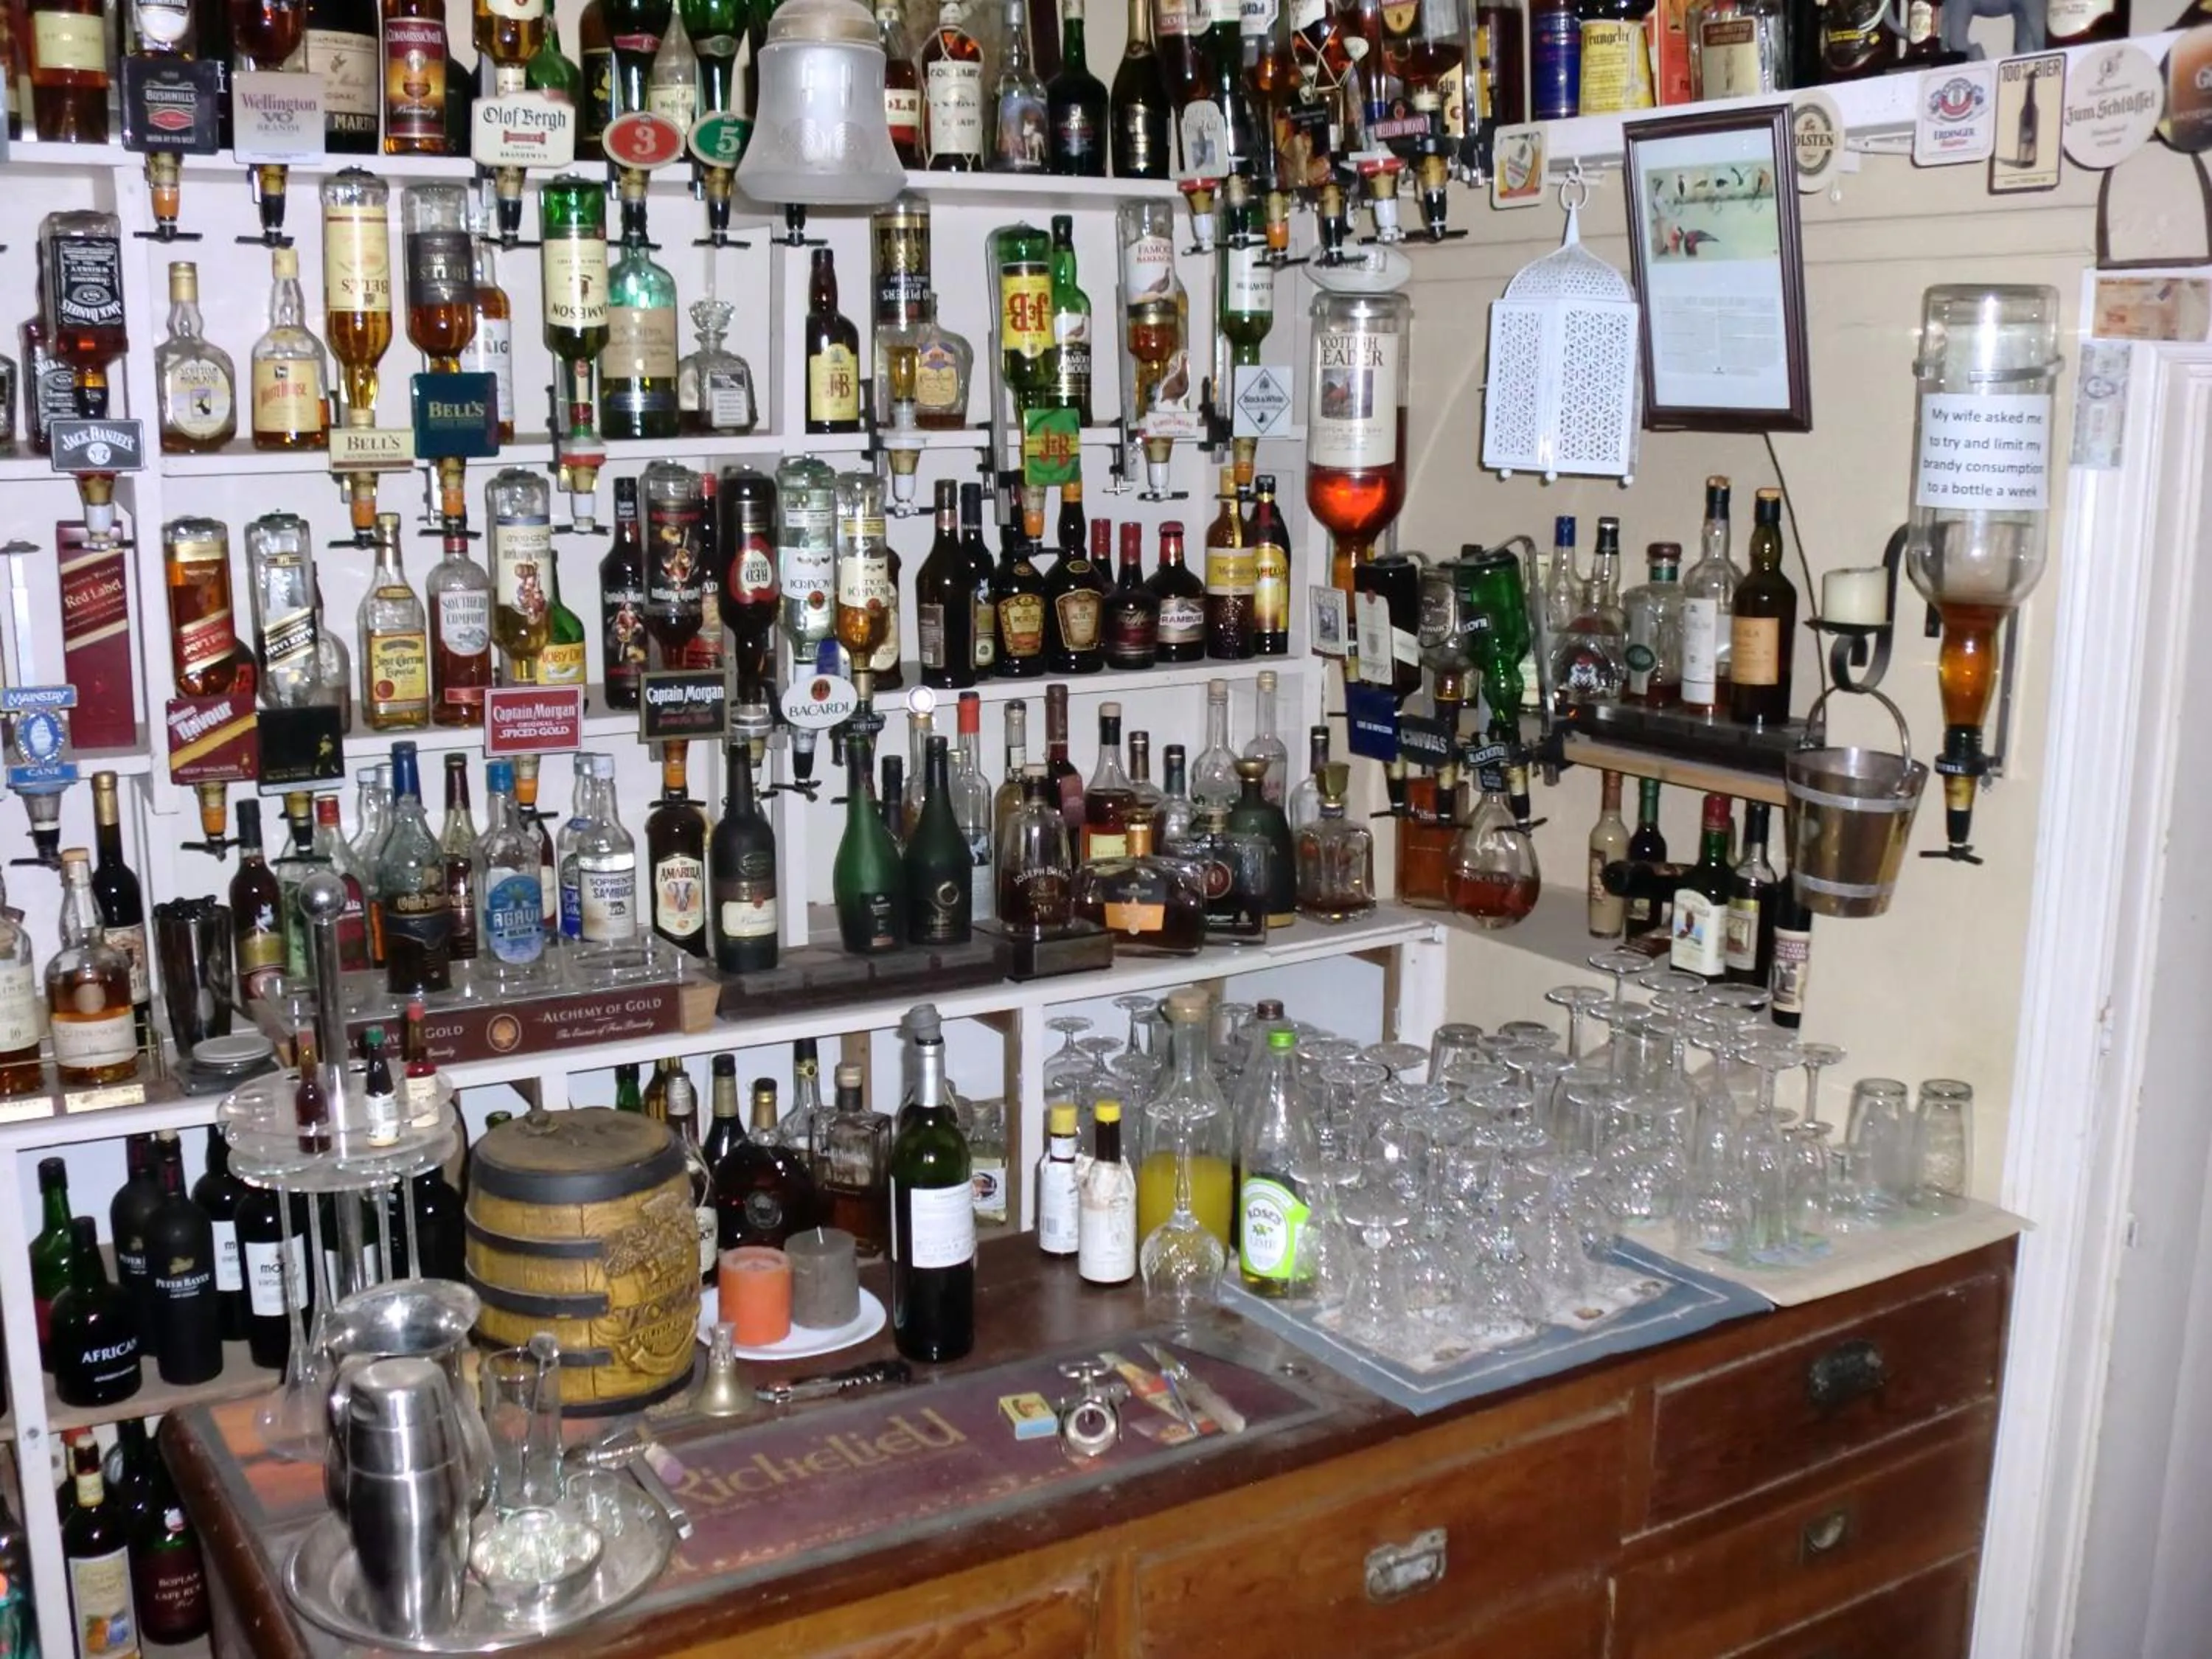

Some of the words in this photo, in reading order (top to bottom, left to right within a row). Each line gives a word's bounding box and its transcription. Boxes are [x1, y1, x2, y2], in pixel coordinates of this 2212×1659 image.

[2034, 59, 2062, 77] BIER
[240, 93, 317, 112] Wellington
[482, 107, 519, 126] Olof
[520, 110, 566, 132] Bergh
[632, 126, 657, 156] 3
[716, 126, 741, 155] 5
[1934, 128, 1976, 140] ERDINGER
[428, 400, 486, 418] BELL'S
[1932, 408, 1949, 422] My
[1952, 409, 1981, 422] wife
[1985, 411, 2025, 424] asked
[2027, 414, 2042, 425] me
[62, 429, 91, 452] JACK
[89, 425, 136, 453] DANIEL'S
[347, 435, 401, 451] BELL'S
[1930, 436, 1941, 447] to
[1943, 437, 1961, 451] try
[1964, 438, 1991, 449] and
[1994, 438, 2024, 451] limit
[2025, 440, 2042, 454] my
[1923, 457, 1963, 473] brandy
[1966, 462, 2045, 477] consumption
[1927, 481, 1938, 493] to
[1941, 484, 1949, 493] a
[1952, 482, 1993, 496] bottle
[1996, 487, 2005, 496] a
[2007, 484, 2038, 498] week
[745, 568, 768, 582] RED
[64, 589, 90, 609] Red
[89, 577, 122, 599] Label
[1159, 613, 1203, 625] RAMBUIE
[7, 689, 69, 706] MAINSTAY
[646, 686, 683, 704] Captain
[684, 685, 724, 702] Morgan
[493, 705, 533, 723] Captain
[533, 703, 576, 720] Morgan
[789, 702, 850, 718] BACARDI
[175, 700, 233, 740] flavour
[498, 728, 538, 739] SPICED
[539, 726, 570, 737] GOLD
[26, 767, 61, 776] CANE
[542, 1004, 604, 1023] ALCHEMY
[605, 1004, 622, 1015] OF
[625, 998, 662, 1014] GOLD
[424, 1025, 464, 1039] GOLD
